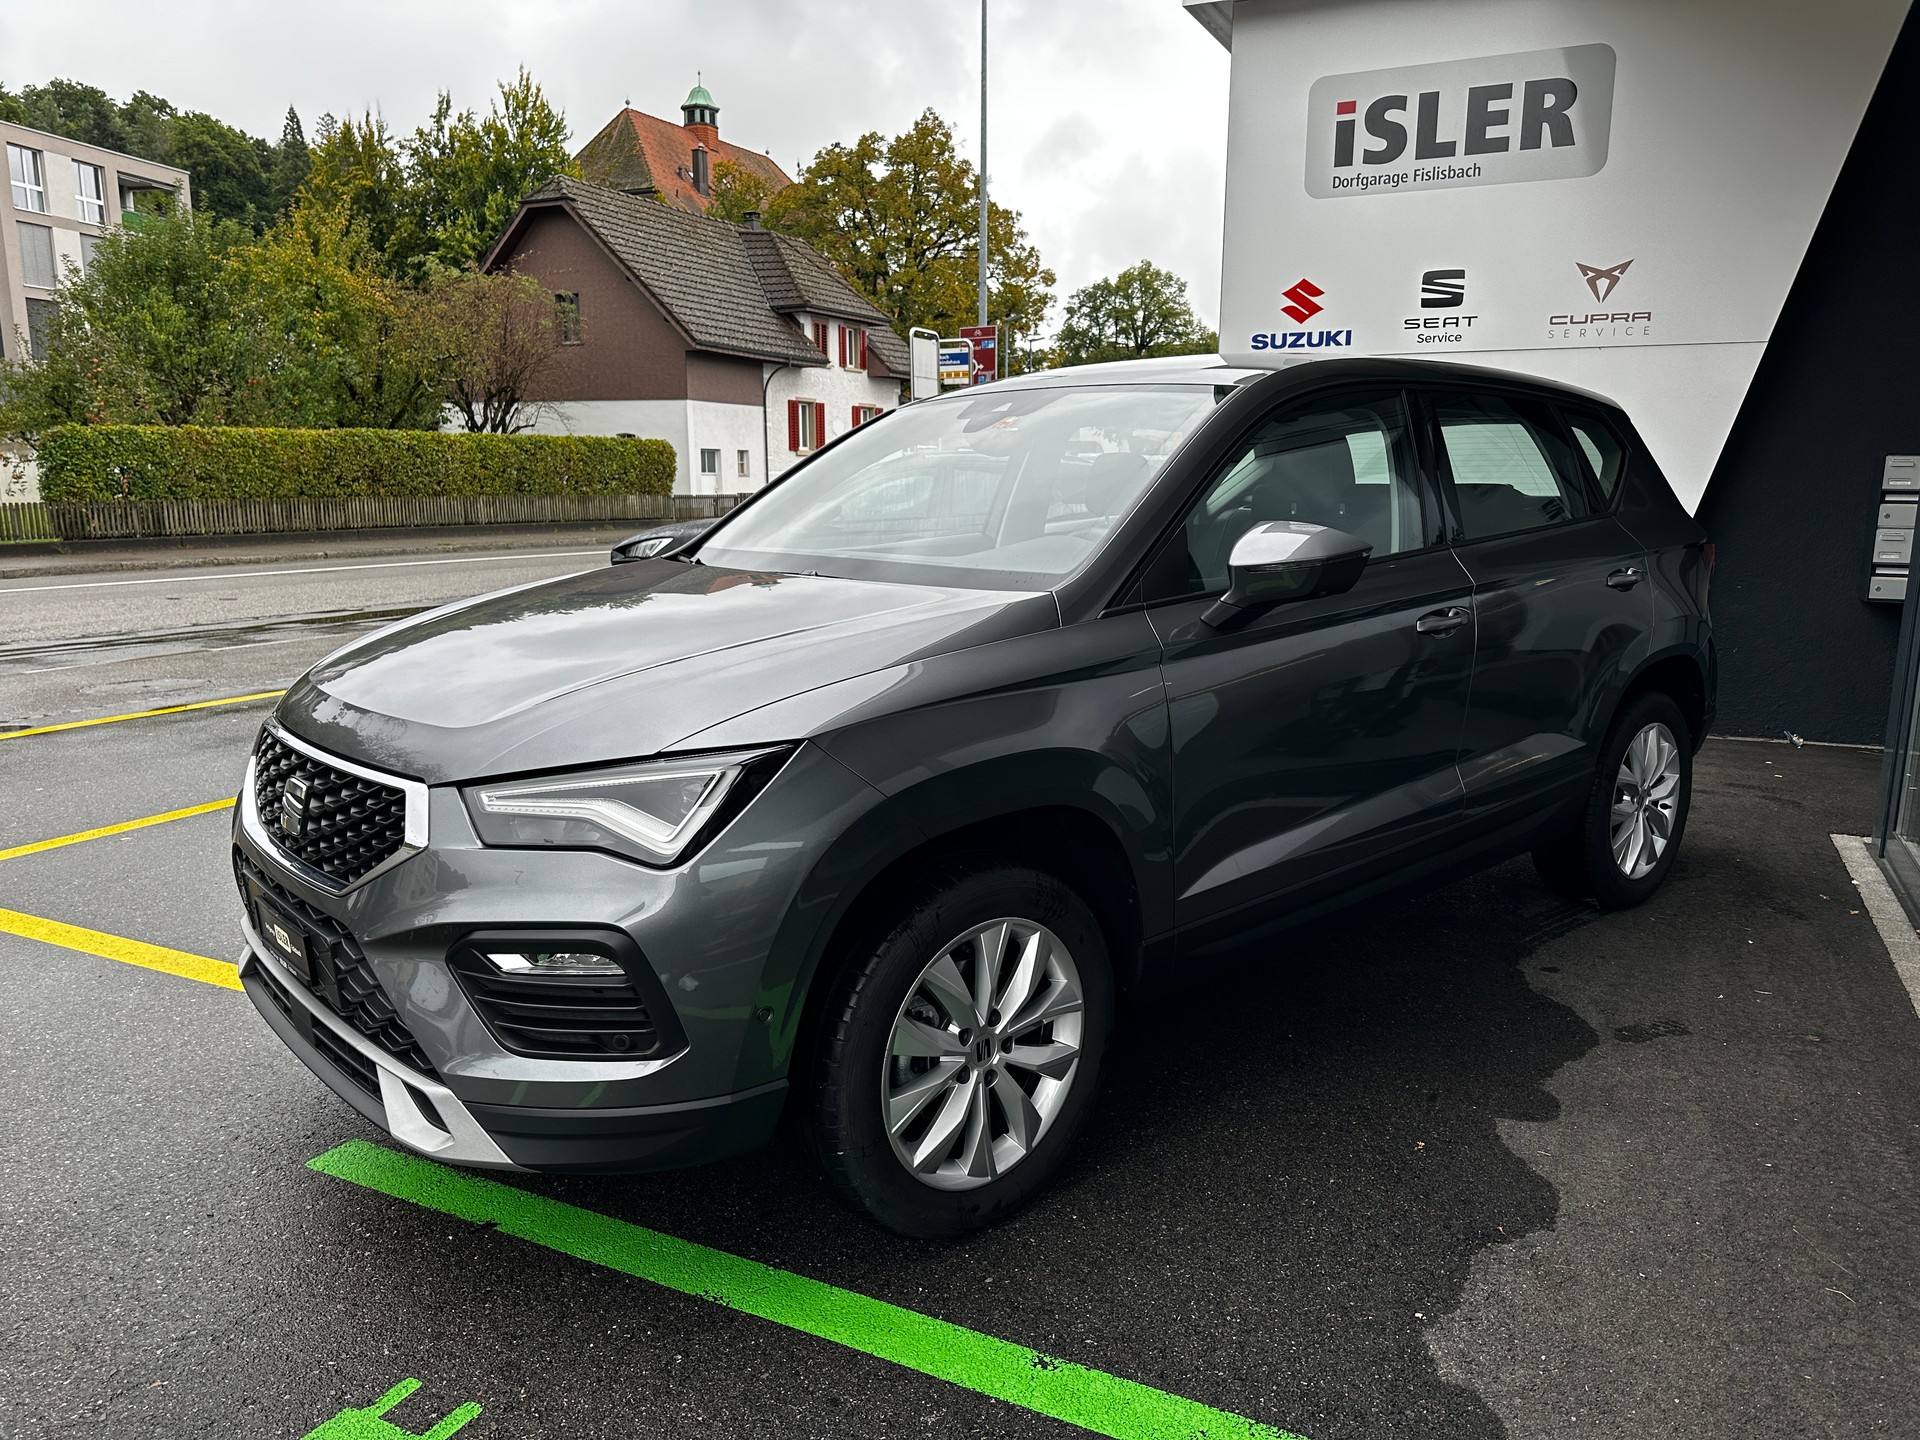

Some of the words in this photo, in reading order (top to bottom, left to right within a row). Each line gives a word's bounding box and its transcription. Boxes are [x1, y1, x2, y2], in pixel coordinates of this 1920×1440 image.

[1332, 170, 1408, 190] Dorfgarage
[1413, 163, 1482, 182] Fislisbach
[1403, 316, 1478, 330] SEAT
[1549, 312, 1651, 325] CUPRA
[1417, 332, 1463, 344] Service
[1548, 326, 1650, 339] SERVICE
[1251, 330, 1352, 350] SUZUKI
